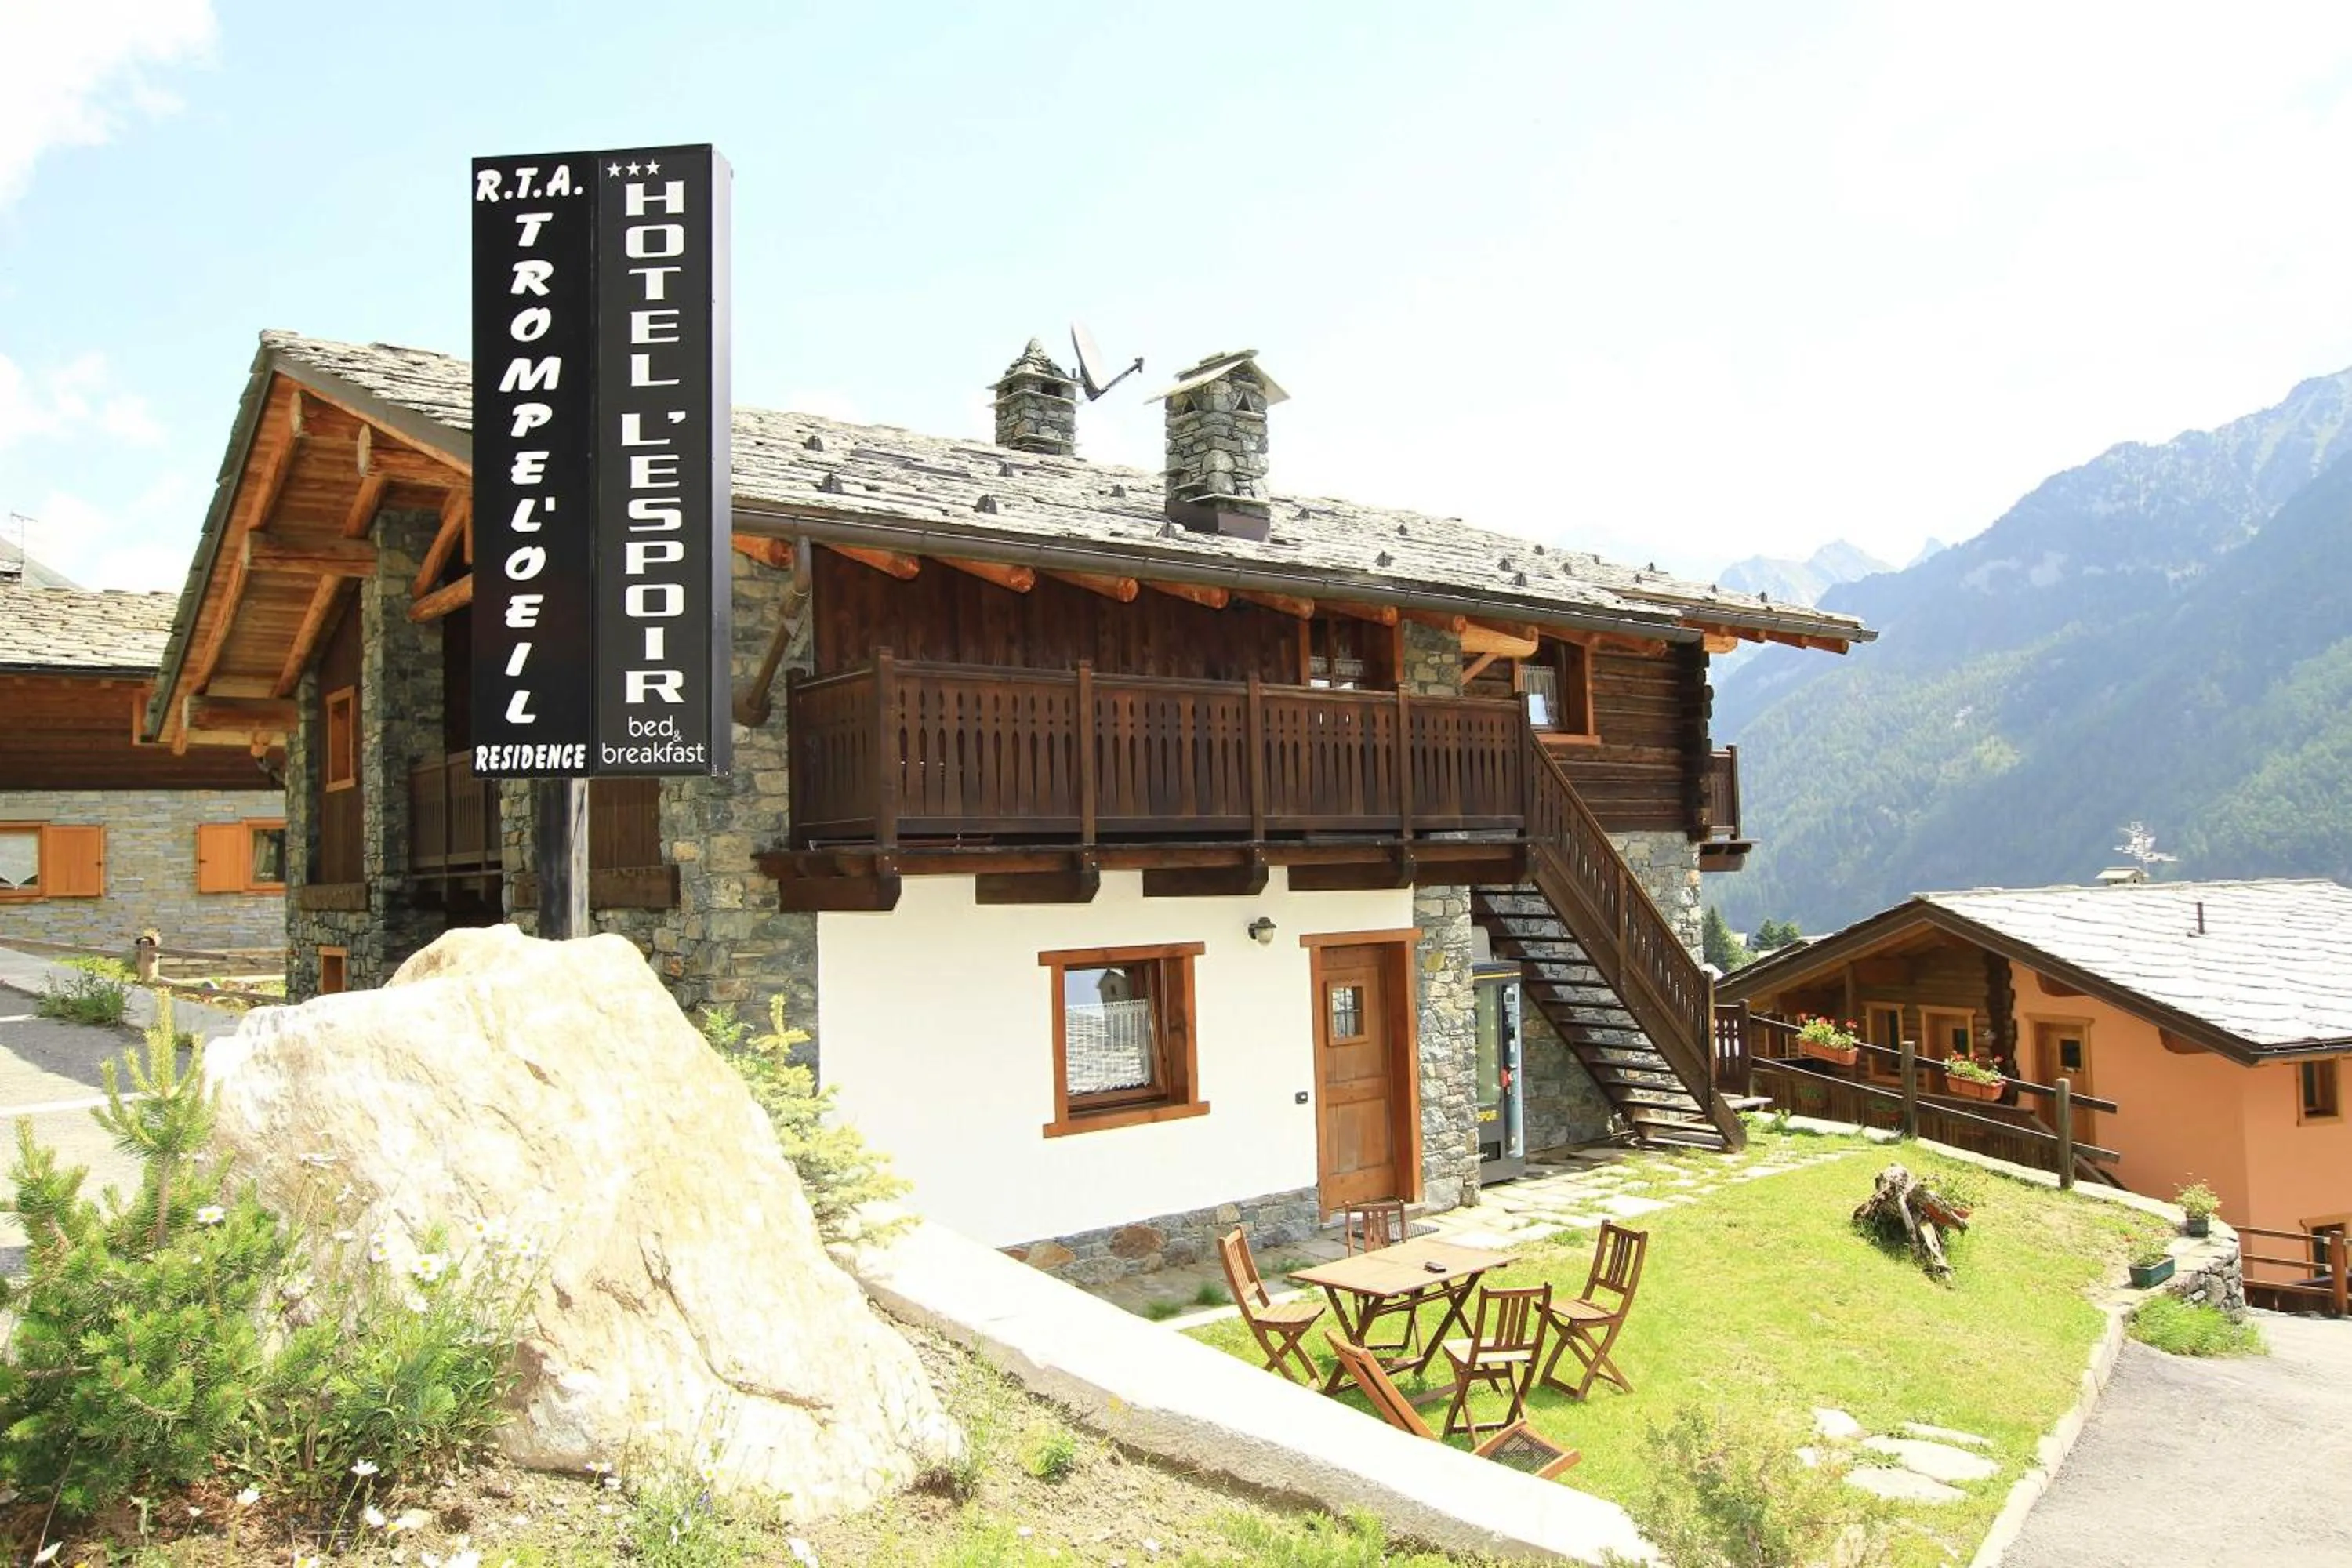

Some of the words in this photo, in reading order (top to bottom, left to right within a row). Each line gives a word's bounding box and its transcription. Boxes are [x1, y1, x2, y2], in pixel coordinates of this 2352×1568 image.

[476, 165, 584, 203] R.T.A.
[625, 180, 684, 387] HOTEL
[621, 410, 686, 704] L'ESPOIR
[628, 715, 673, 738] bed
[475, 743, 586, 772] RESIDENCE
[601, 741, 705, 764] breakfast
